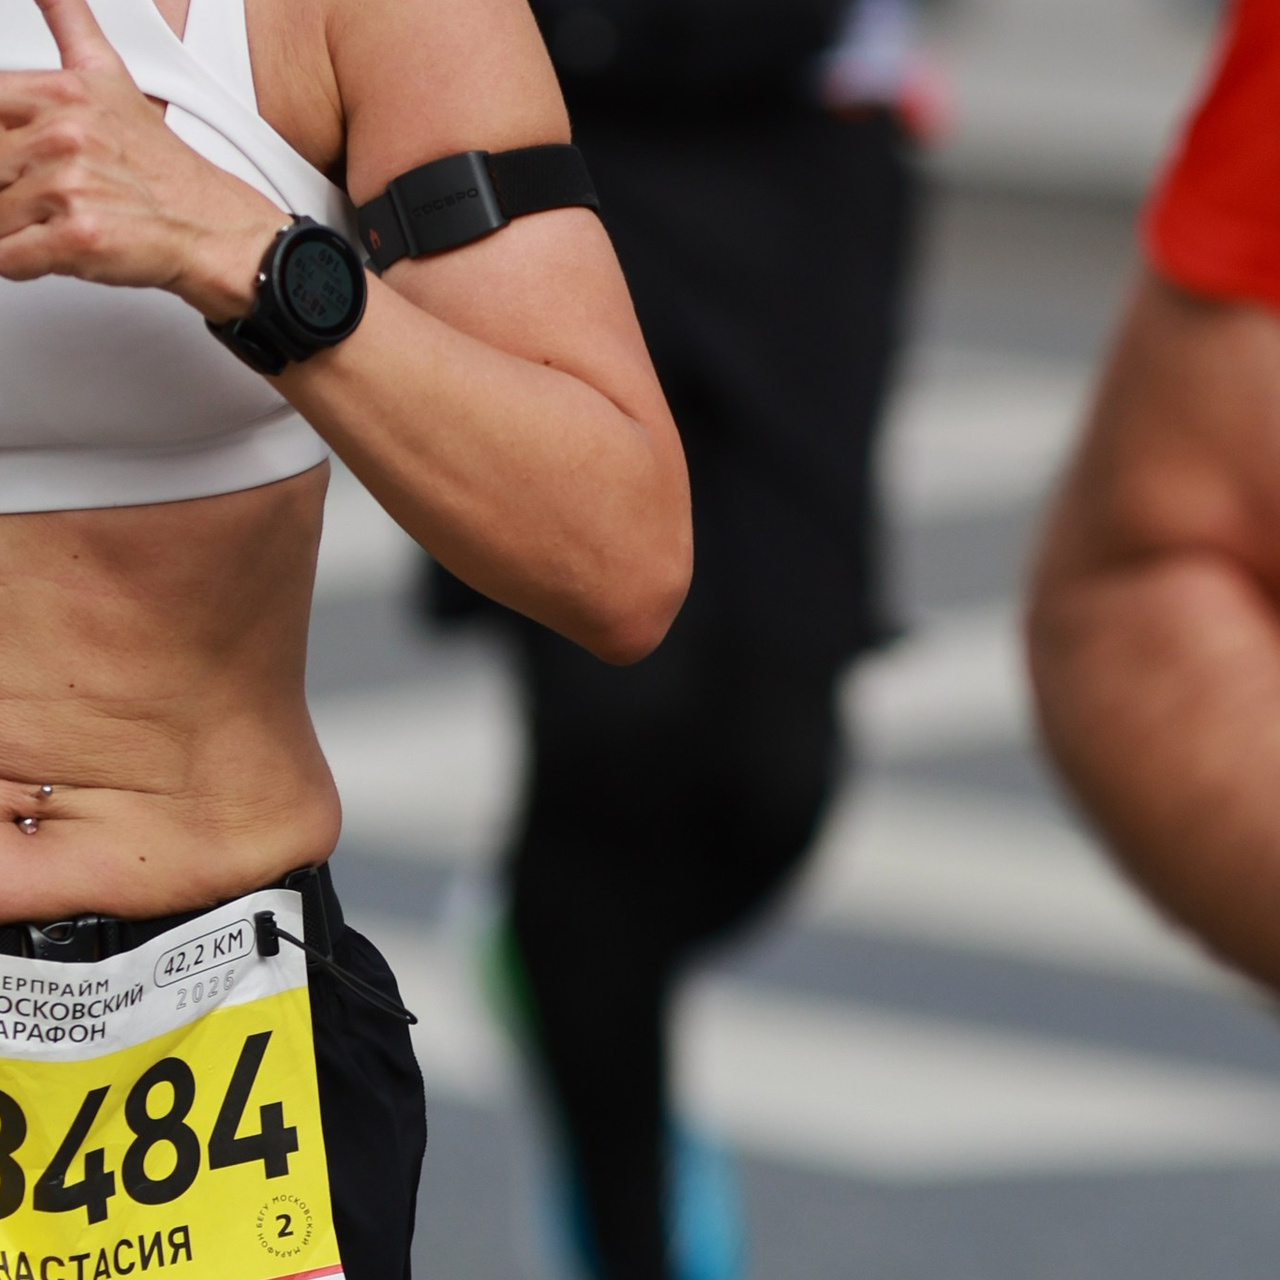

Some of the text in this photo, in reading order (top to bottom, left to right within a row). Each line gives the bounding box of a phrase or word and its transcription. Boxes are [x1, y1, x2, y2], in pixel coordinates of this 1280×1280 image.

[163, 945, 206, 977] 42,2
[176, 969, 234, 1010] 2026
[275, 1213, 294, 1238] 2
